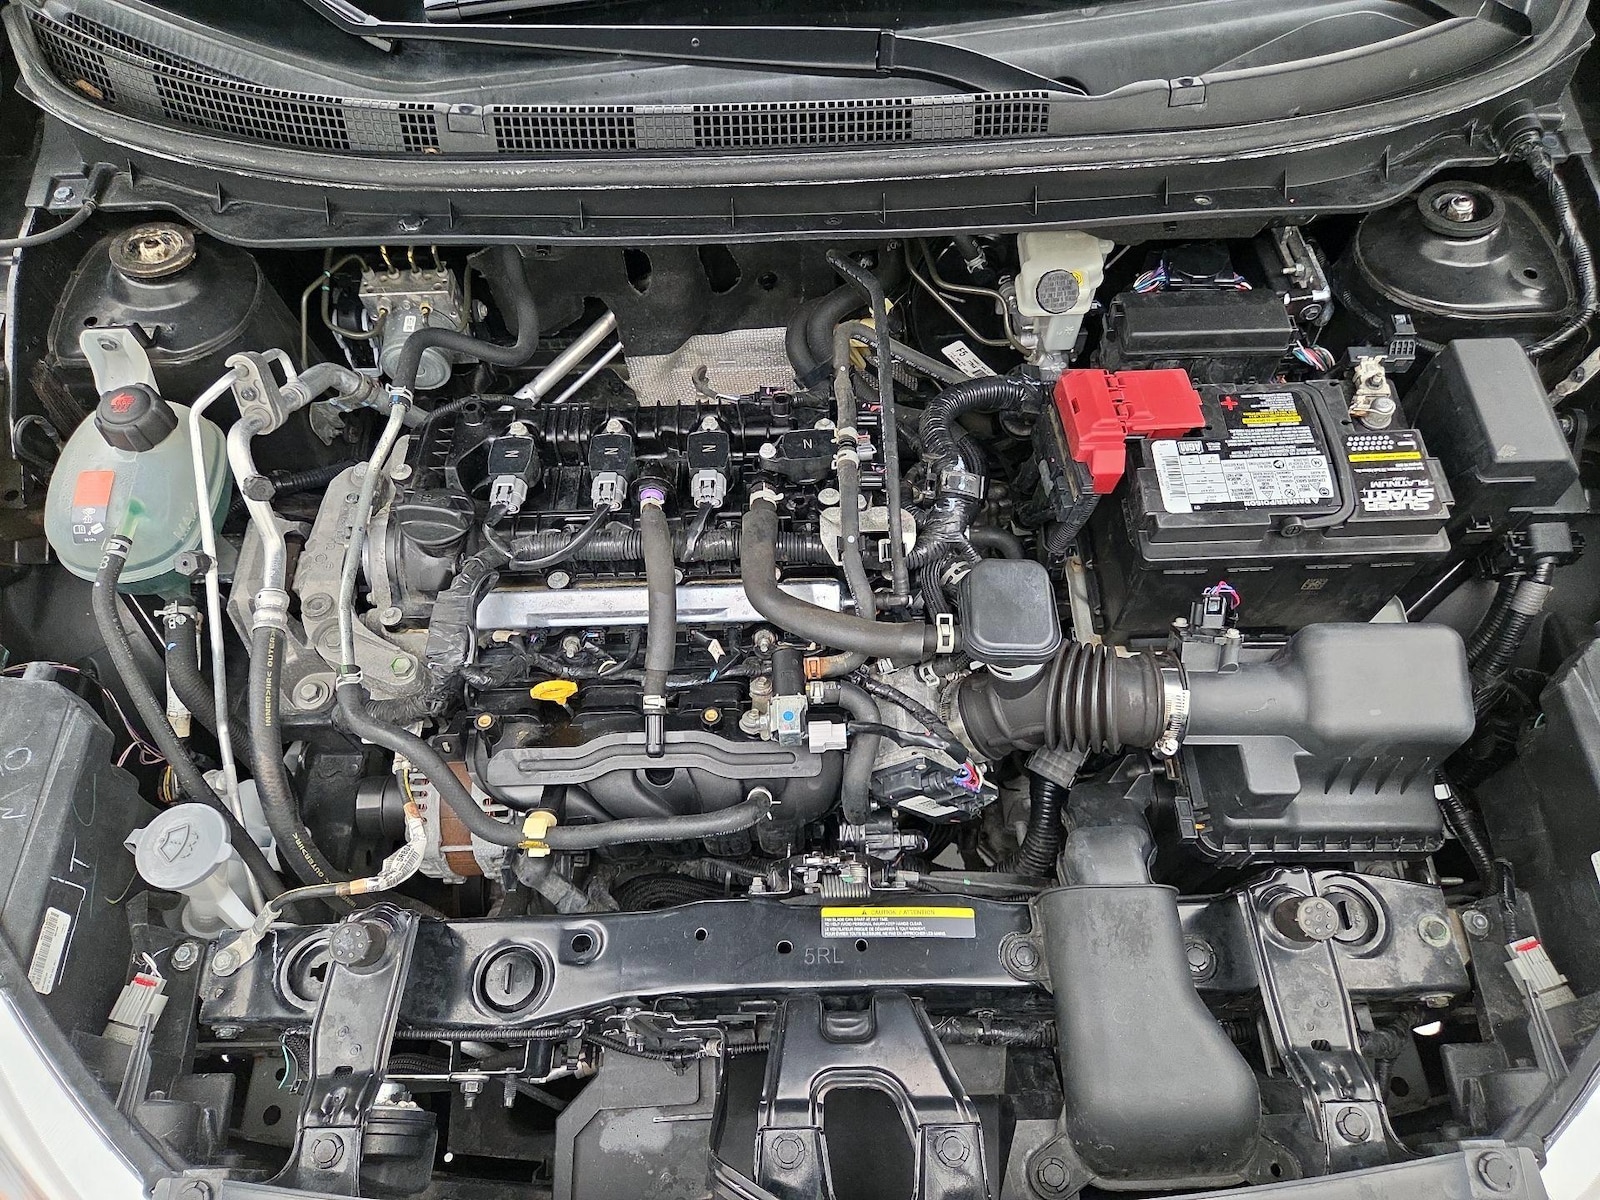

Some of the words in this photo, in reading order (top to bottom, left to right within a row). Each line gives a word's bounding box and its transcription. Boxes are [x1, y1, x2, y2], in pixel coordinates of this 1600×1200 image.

[1370, 479, 1429, 488] PLATINUM
[1360, 488, 1434, 502] START
[1364, 500, 1430, 511] SUPER
[804, 947, 844, 965] 5RL
